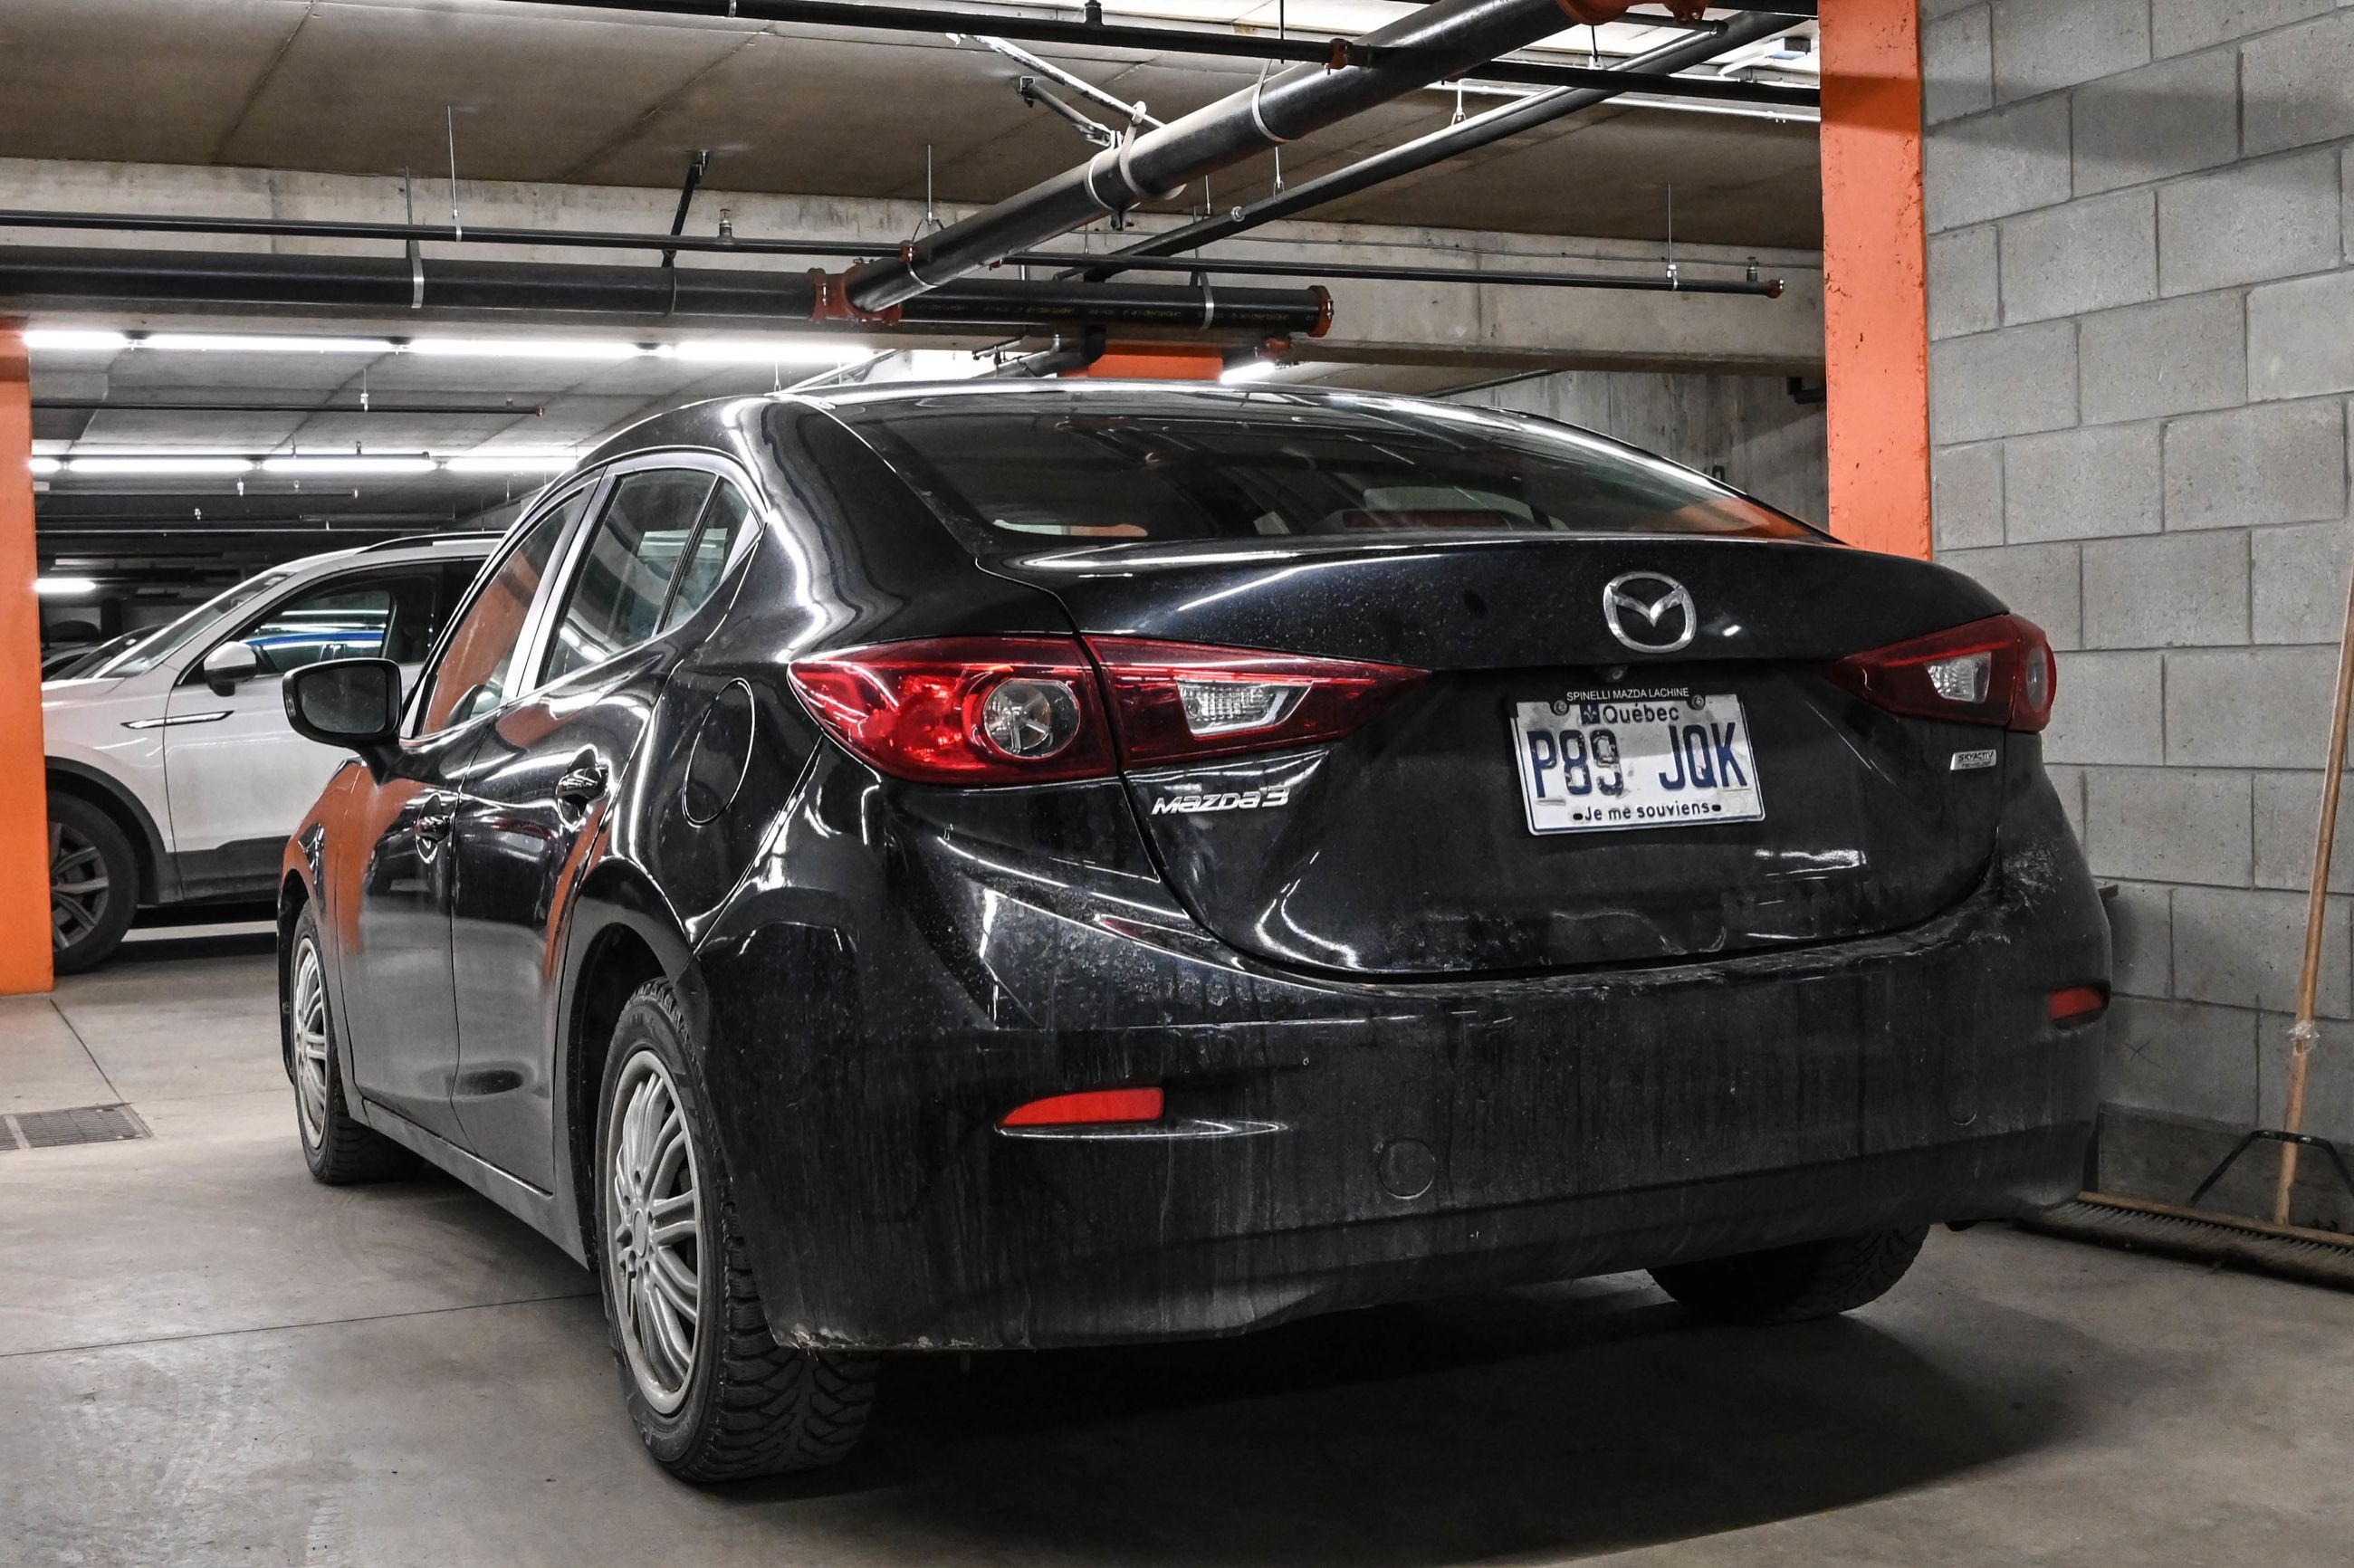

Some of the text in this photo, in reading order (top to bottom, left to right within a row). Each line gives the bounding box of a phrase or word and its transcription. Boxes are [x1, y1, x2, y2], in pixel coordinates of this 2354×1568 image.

[1566, 687, 1689, 702] SPINELLI MAZDA LACHINE
[1603, 703, 1679, 724] Québec
[1526, 722, 1747, 798] P89 JQK
[1584, 800, 1709, 821] Je me souviens
